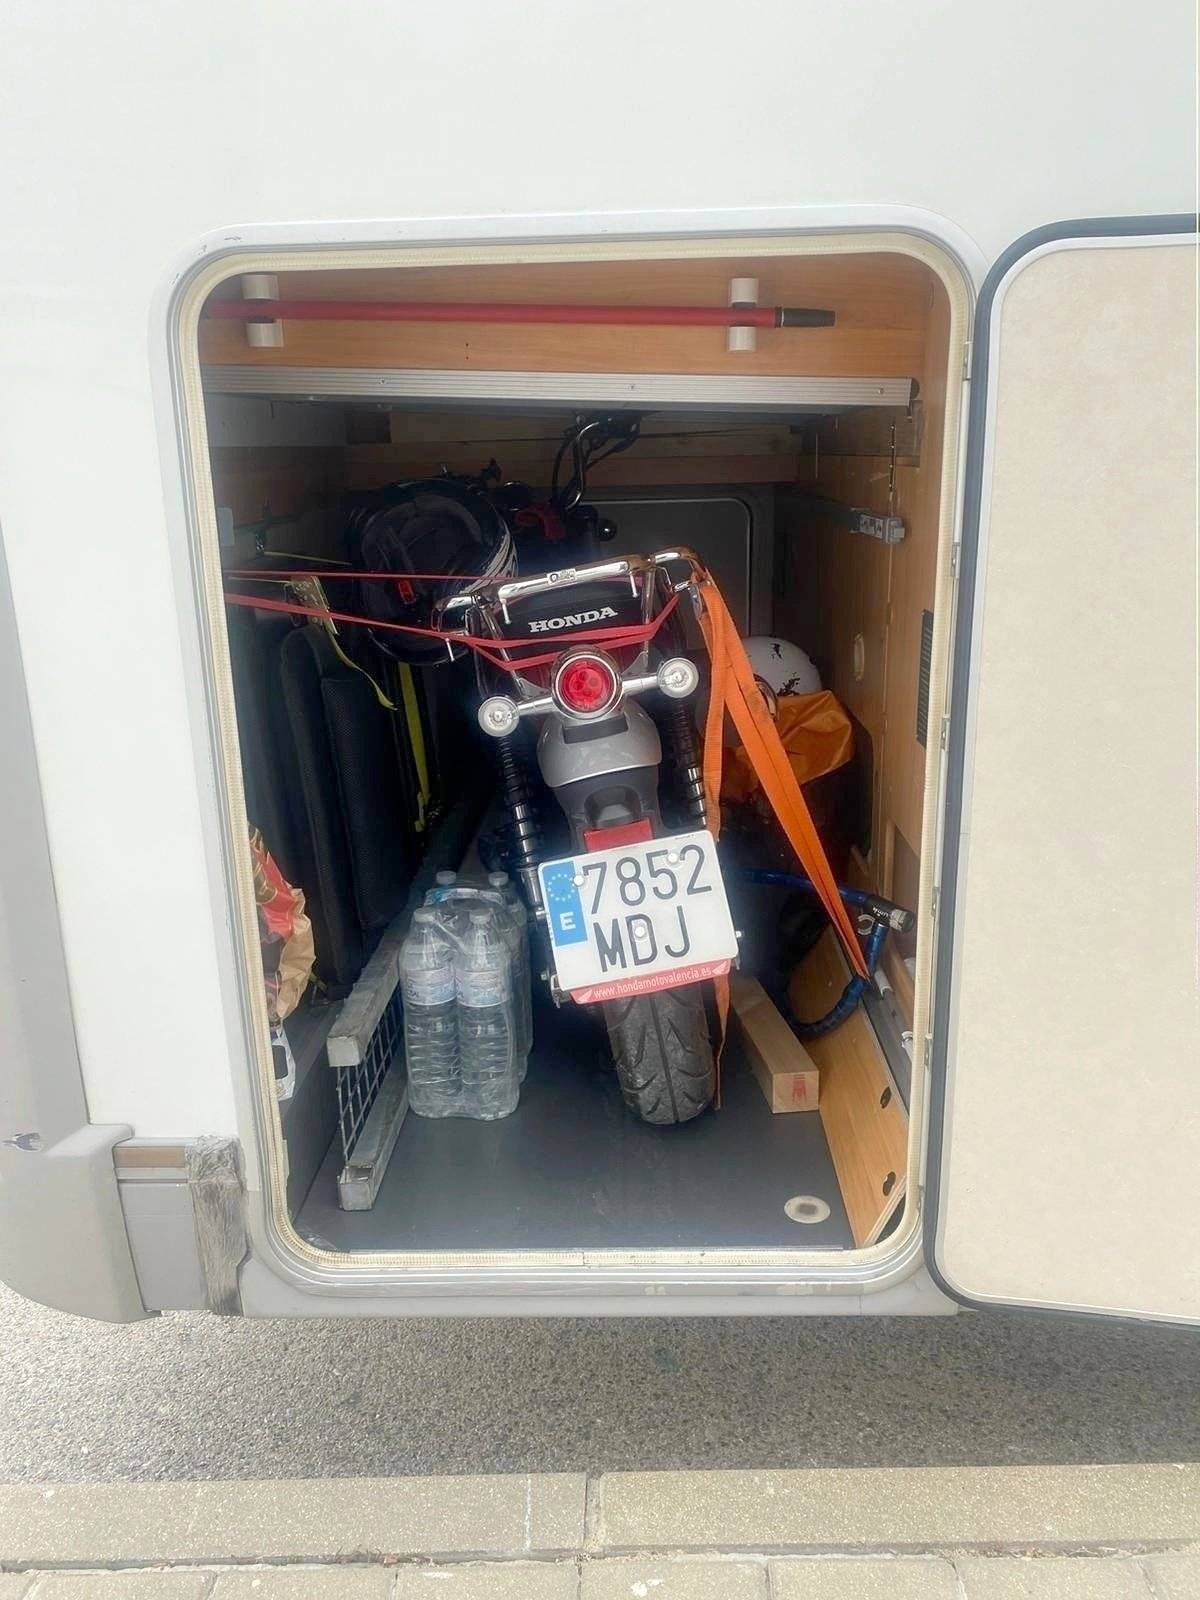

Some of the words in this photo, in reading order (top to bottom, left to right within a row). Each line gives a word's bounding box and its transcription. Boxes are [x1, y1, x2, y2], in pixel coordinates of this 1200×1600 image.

[528, 606, 618, 633] HONDA
[582, 844, 712, 915] 7852
[559, 911, 577, 931] E
[593, 905, 691, 973] MDJ
[594, 966, 712, 999] www.hondamotovalencia.es
